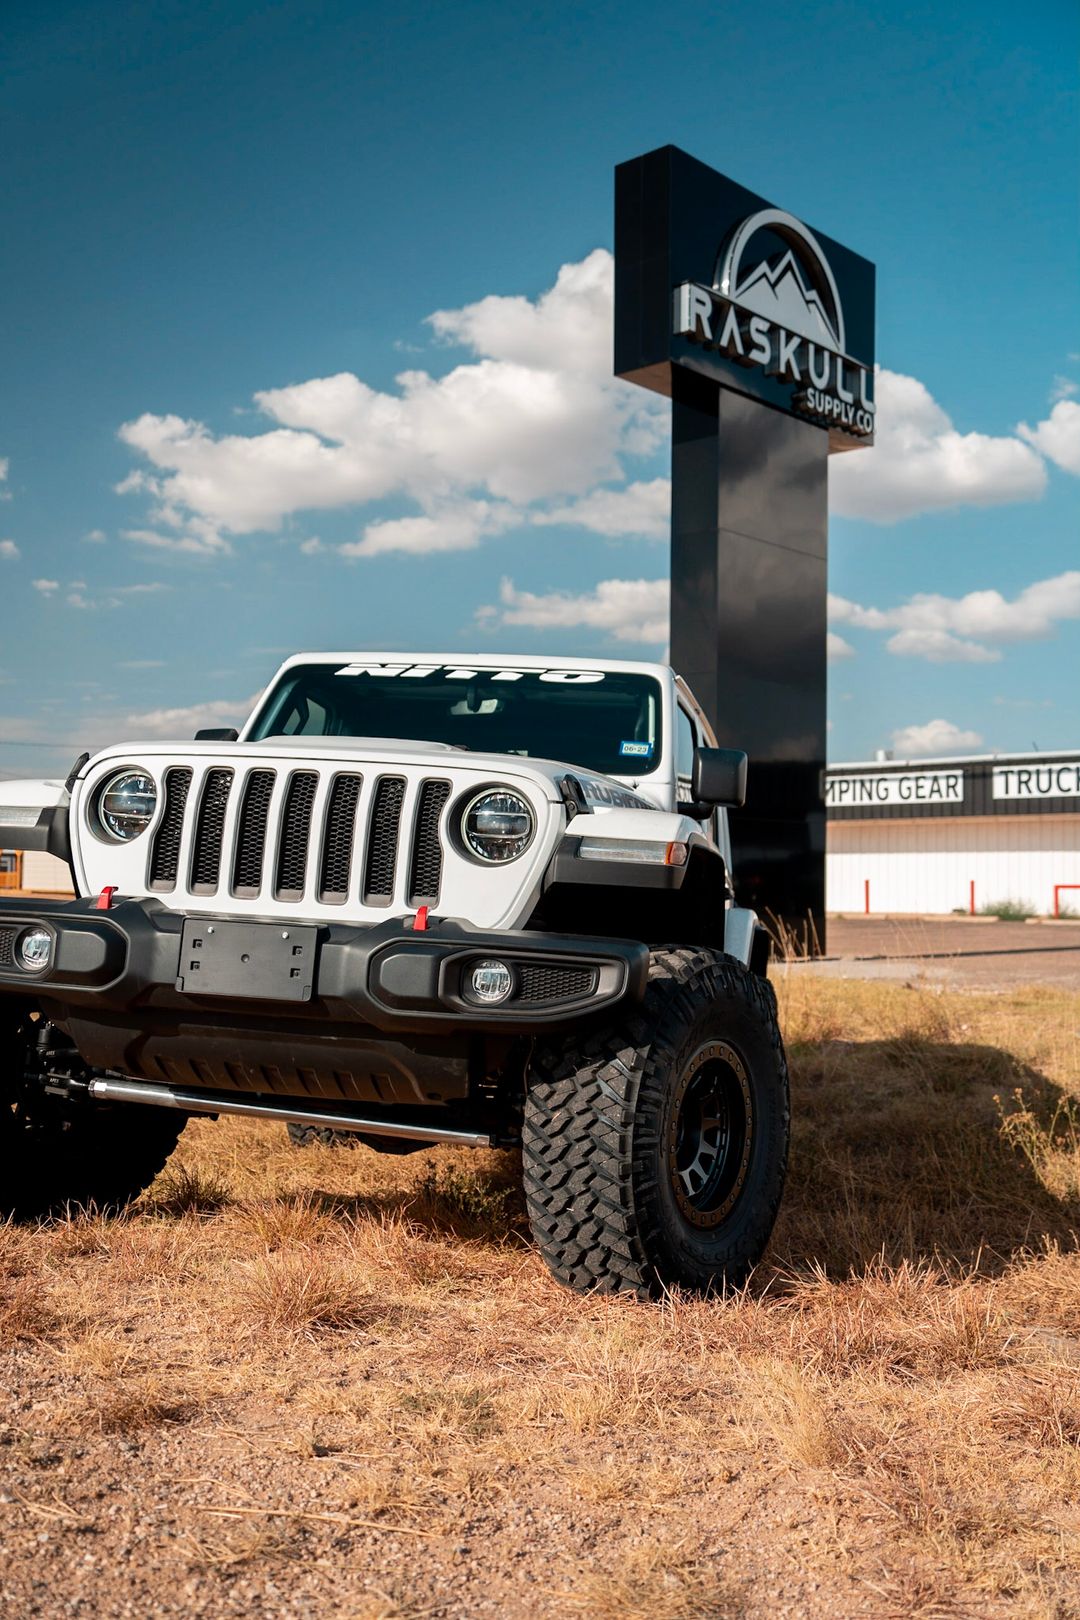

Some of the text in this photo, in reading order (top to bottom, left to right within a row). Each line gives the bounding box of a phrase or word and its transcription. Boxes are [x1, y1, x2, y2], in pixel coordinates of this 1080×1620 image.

[681, 282, 876, 414] RASKULL
[806, 387, 855, 425] SUPPLY
[334, 663, 606, 683] NITTO
[898, 774, 959, 800] GEAR
